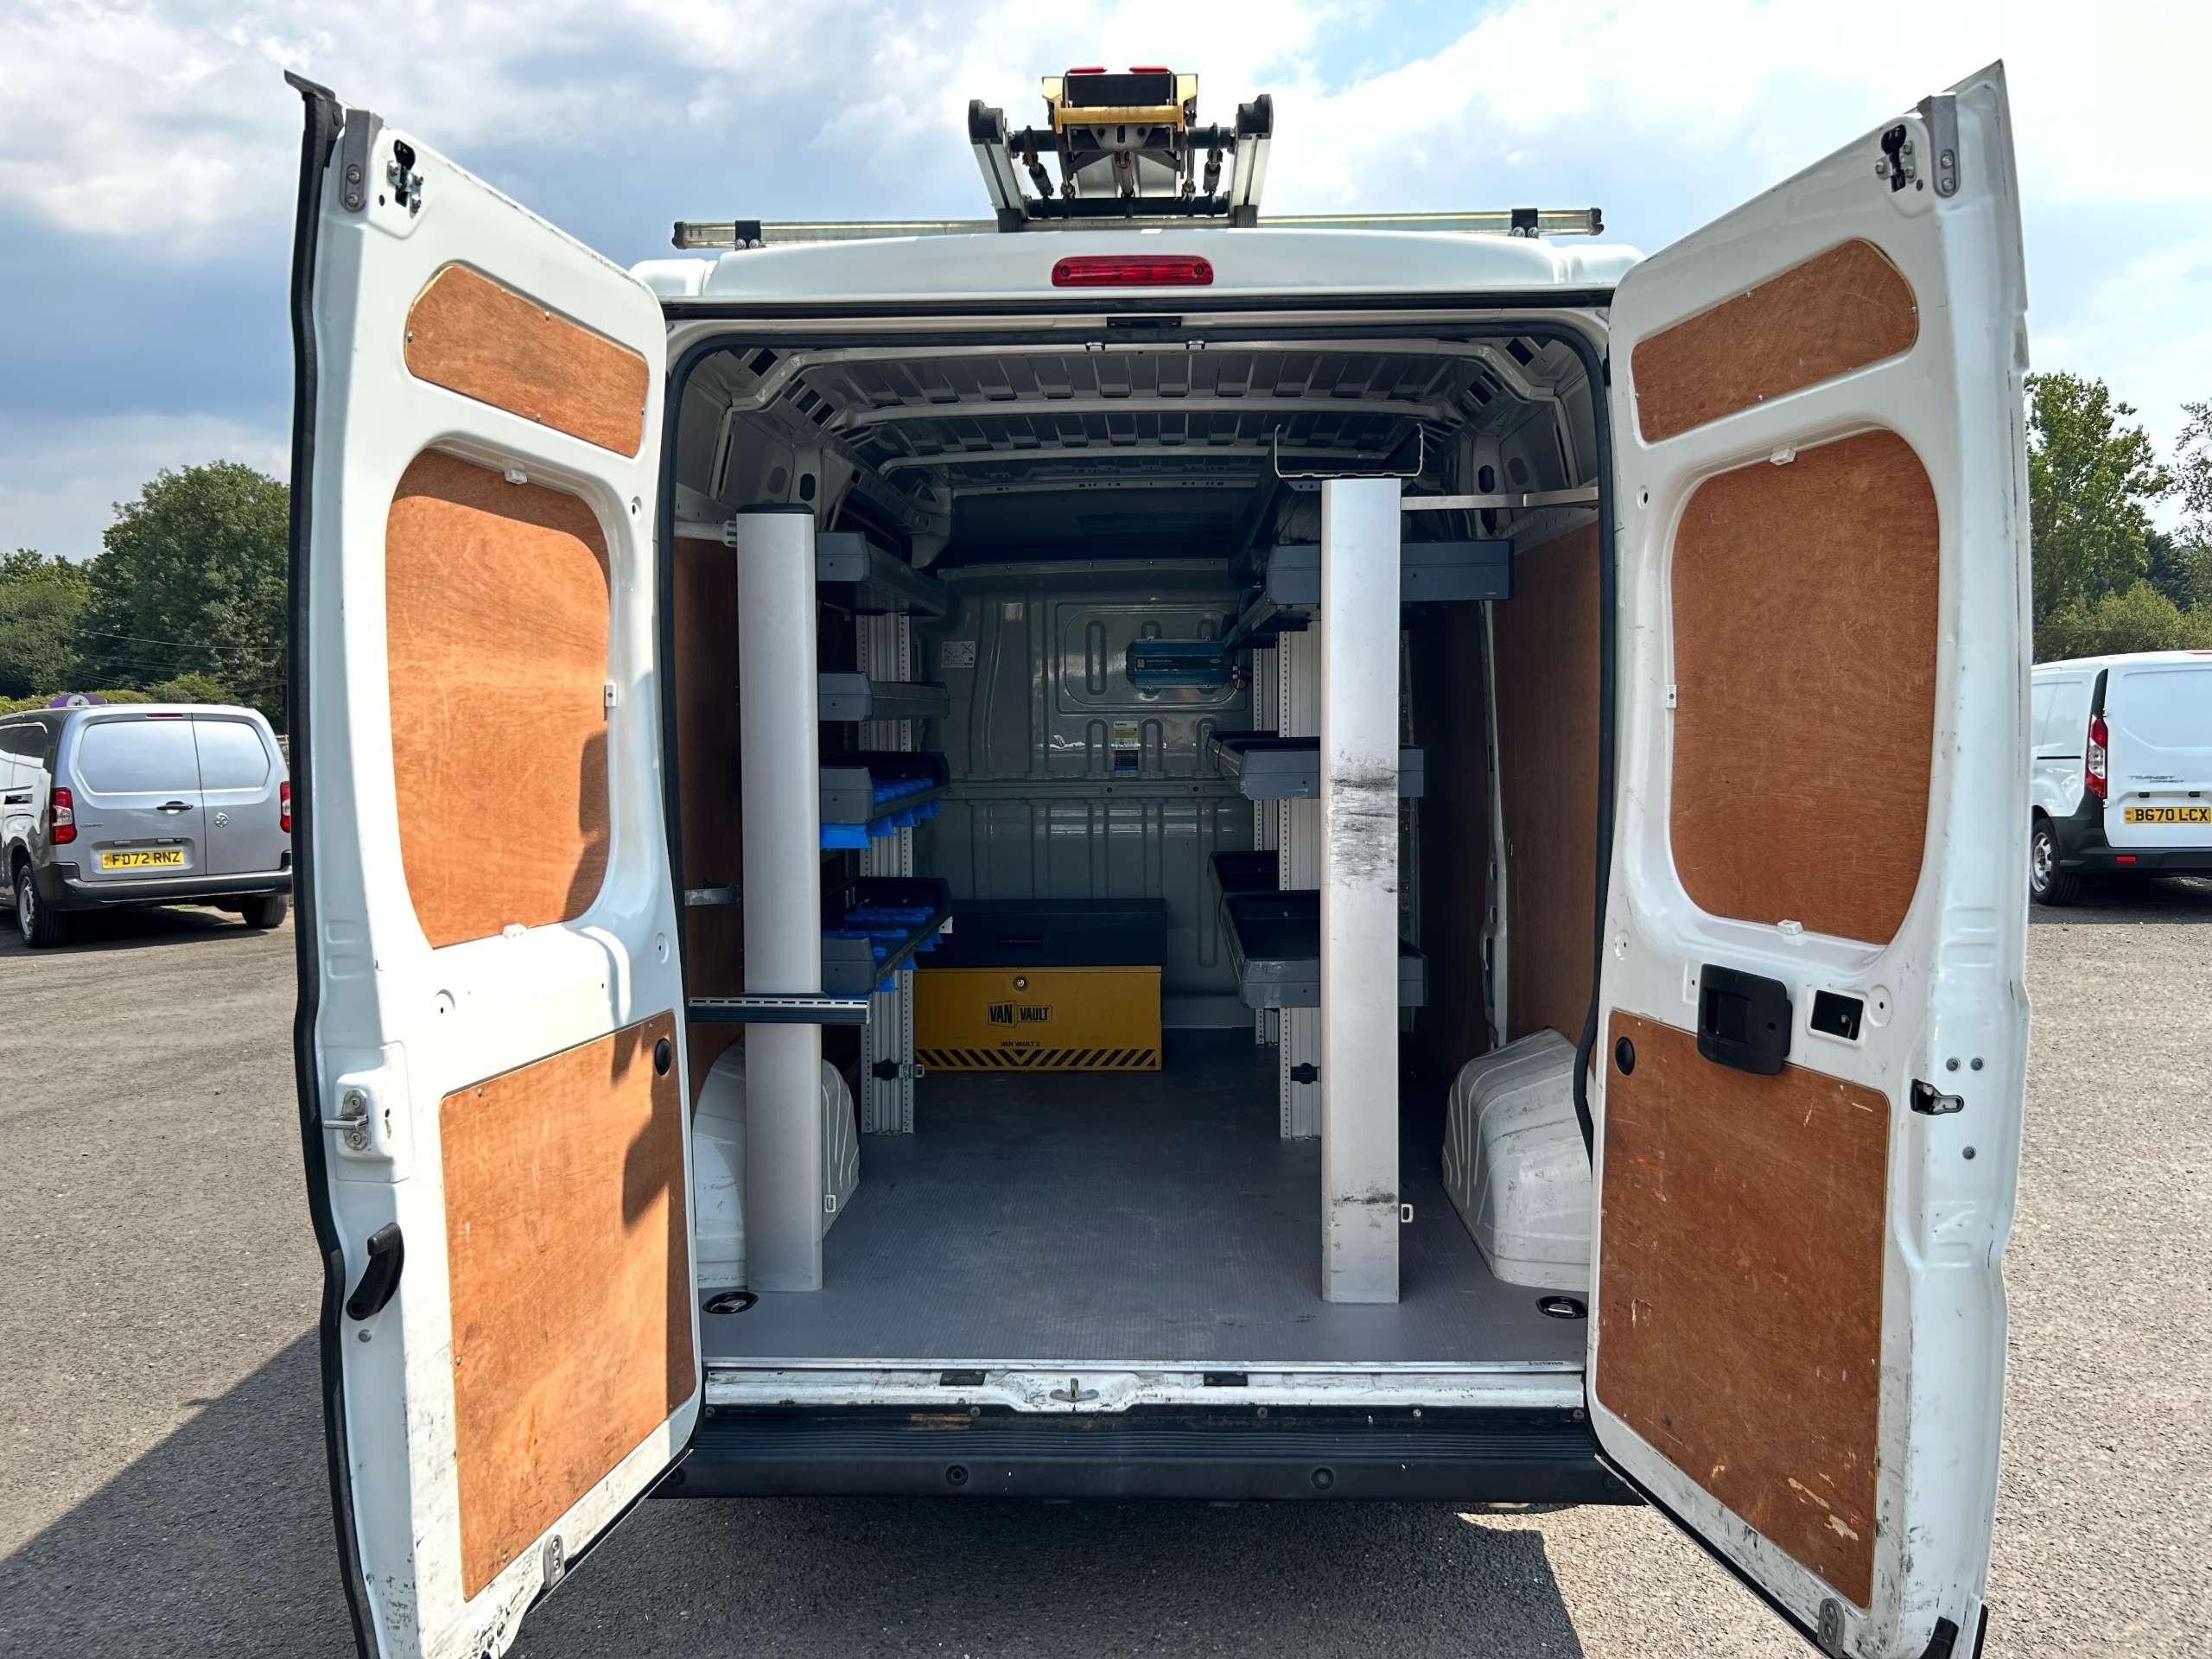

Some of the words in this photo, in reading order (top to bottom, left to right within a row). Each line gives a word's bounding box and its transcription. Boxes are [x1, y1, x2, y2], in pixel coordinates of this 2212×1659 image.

[2135, 808, 2175, 822] B670
[2178, 808, 2209, 822] LCX
[112, 853, 149, 866] FD72
[153, 851, 181, 863] RNZ
[989, 1004, 1013, 1024] VAN
[1020, 1007, 1050, 1021] VAULT
